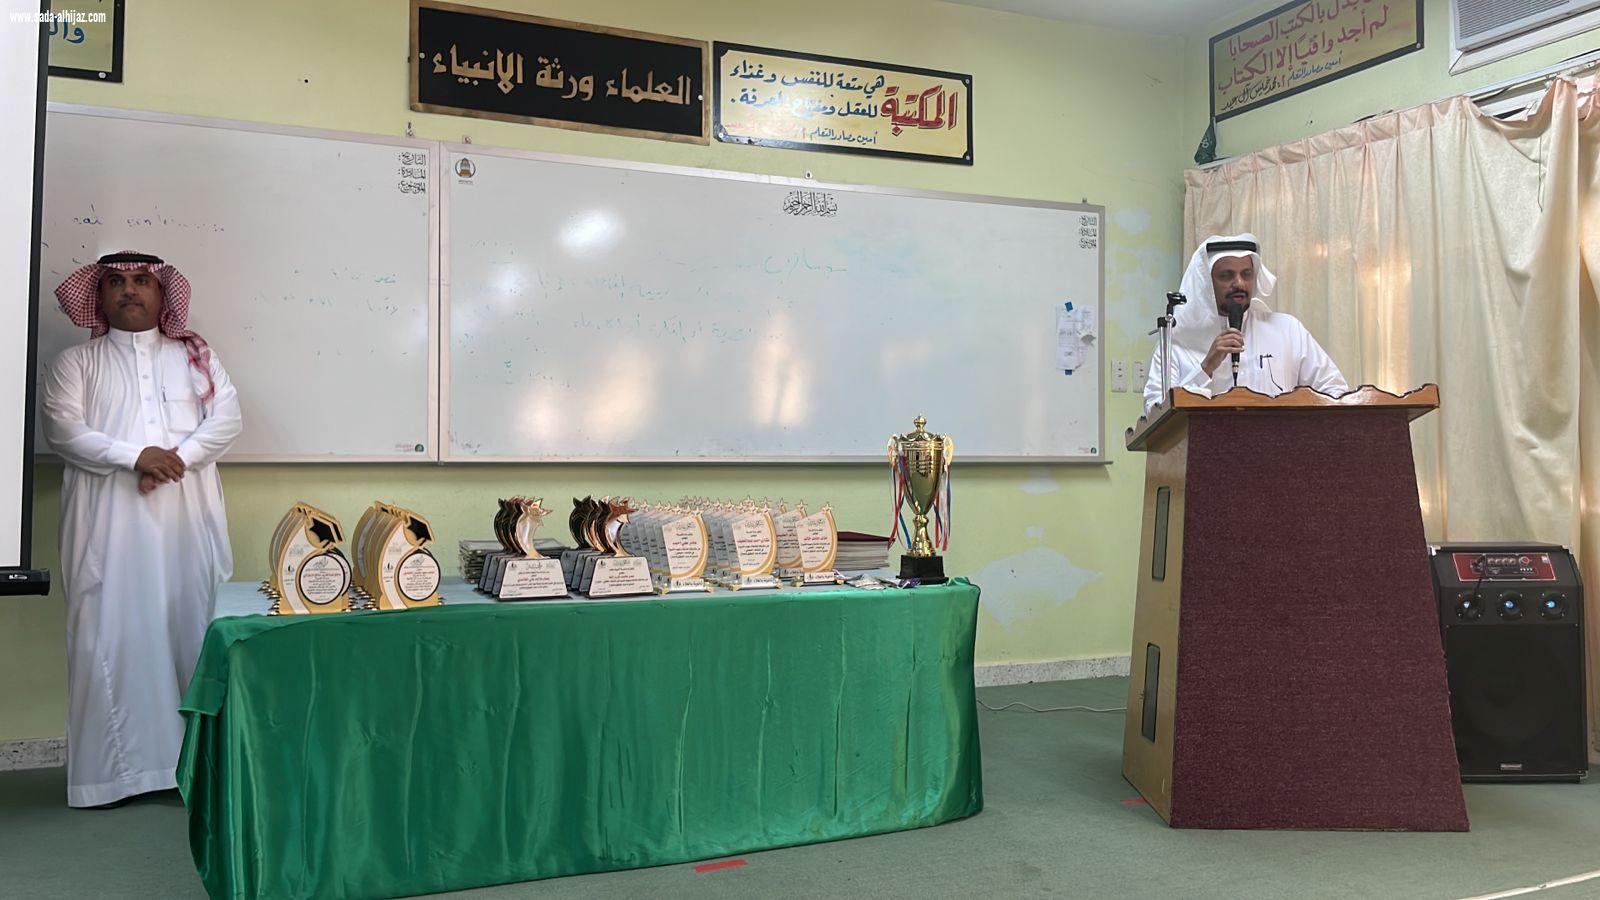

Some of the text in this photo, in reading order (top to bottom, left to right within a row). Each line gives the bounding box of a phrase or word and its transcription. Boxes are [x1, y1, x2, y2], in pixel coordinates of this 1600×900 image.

[1369, 4, 1389, 40] لم
[535, 55, 595, 101] ورثة
[605, 67, 692, 105] العلماء
[780, 70, 834, 88] للنفس
[836, 72, 864, 91] متعة
[864, 74, 886, 99] هي
[1217, 47, 1273, 95] الكتاب
[837, 100, 878, 118] للعقل
[880, 84, 959, 137] المكتبة
